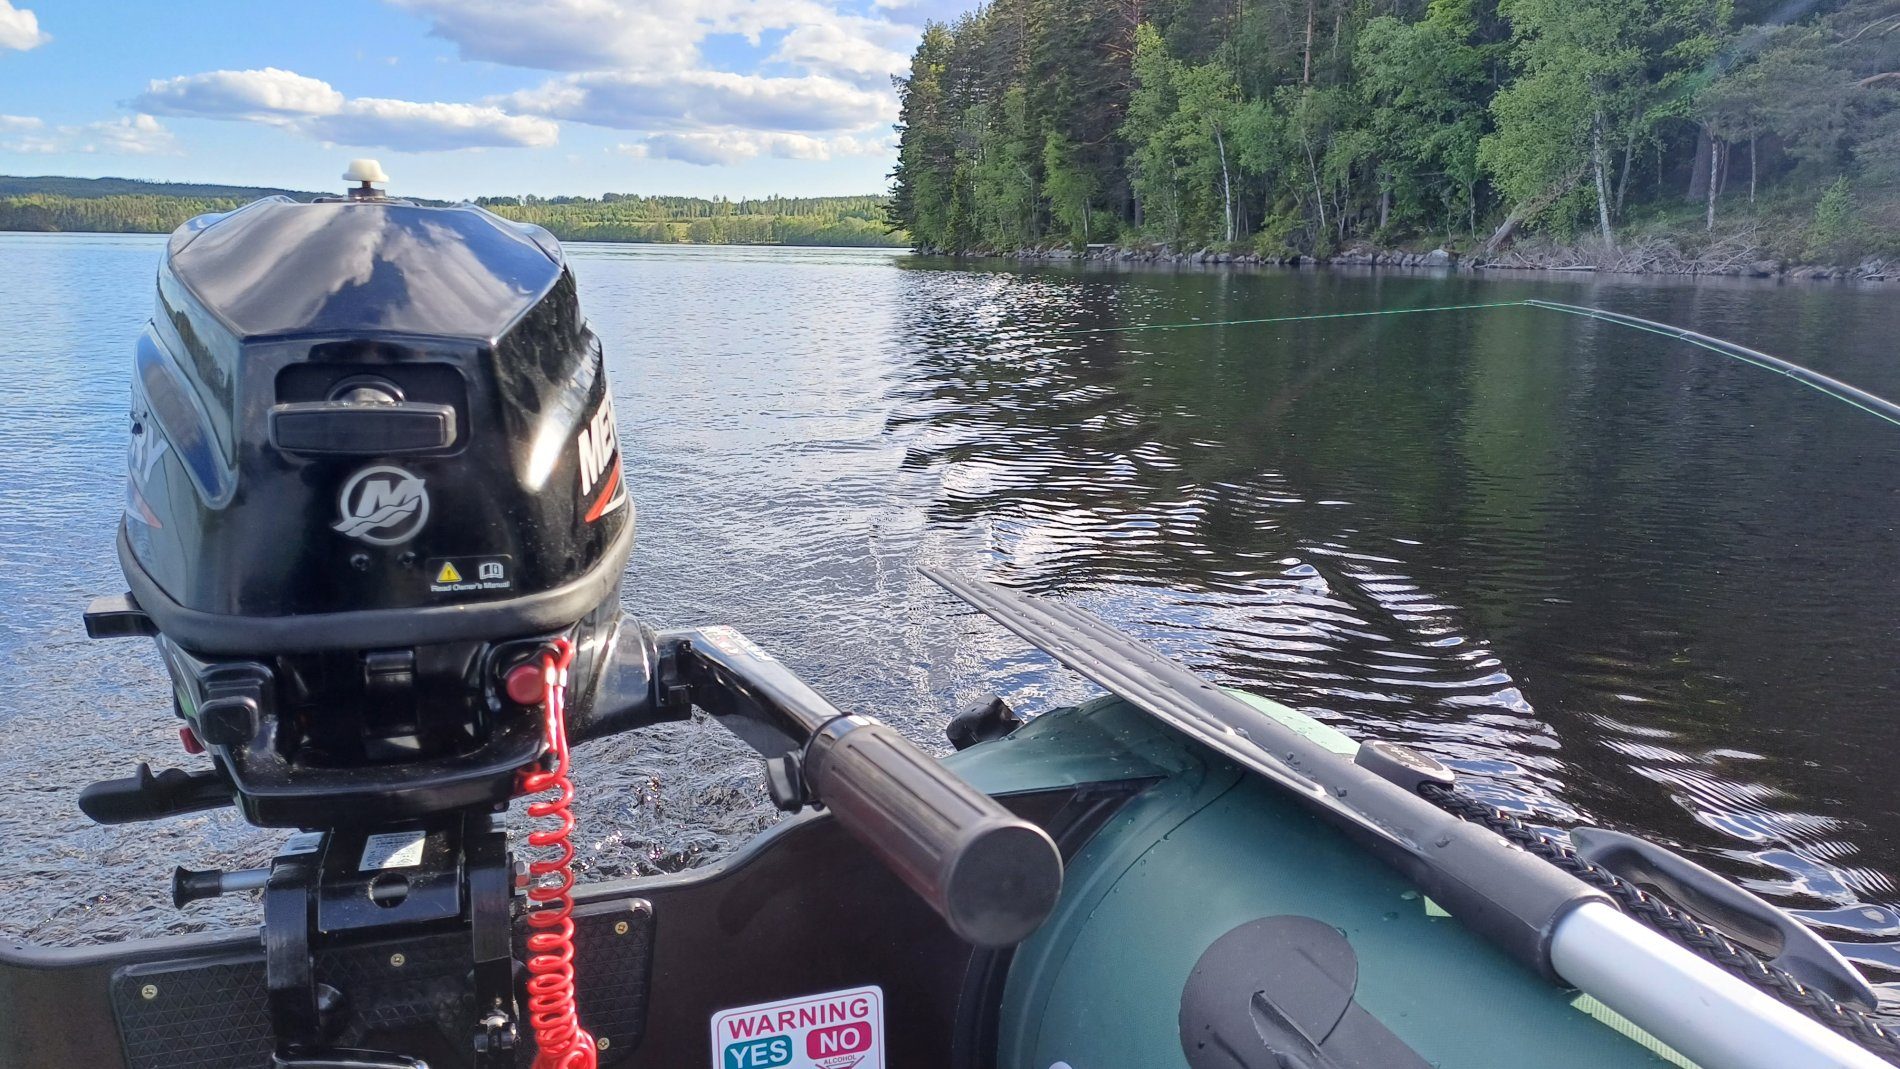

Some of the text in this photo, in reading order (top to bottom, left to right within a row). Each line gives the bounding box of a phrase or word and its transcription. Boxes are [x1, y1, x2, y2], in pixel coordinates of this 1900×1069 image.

[430, 580, 511, 592] Read Owner's Manual
[728, 998, 868, 1039] WARNING
[820, 1027, 861, 1054] NO
[730, 1040, 788, 1069] YES
[823, 1054, 857, 1066] ALCOHOL
